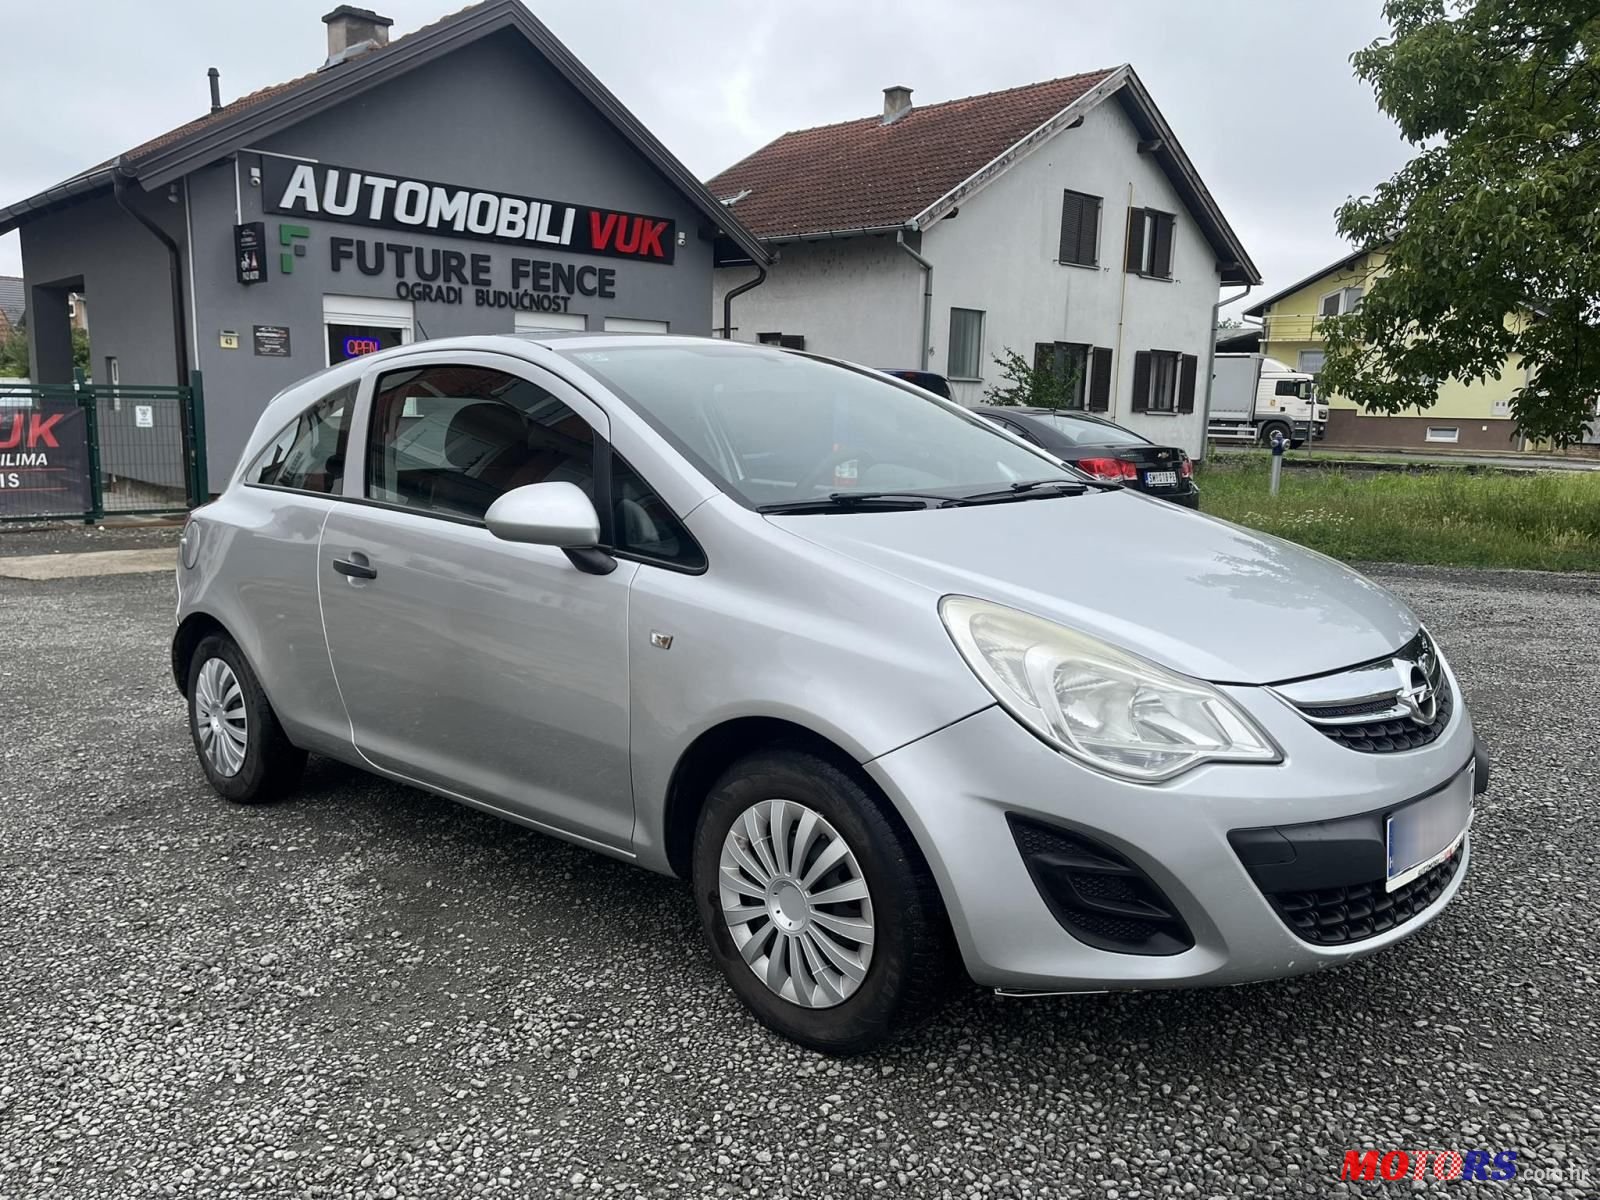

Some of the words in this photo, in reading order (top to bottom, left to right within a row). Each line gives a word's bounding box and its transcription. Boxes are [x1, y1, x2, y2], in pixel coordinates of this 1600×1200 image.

[279, 165, 576, 246] AUTOMOBILI
[590, 210, 669, 258] VUK
[330, 236, 492, 287] FUTURE
[511, 257, 617, 299] FENCE
[396, 281, 463, 305] OGRADI
[475, 288, 571, 313] BUDUĆNOST
[347, 339, 378, 355] OPEN
